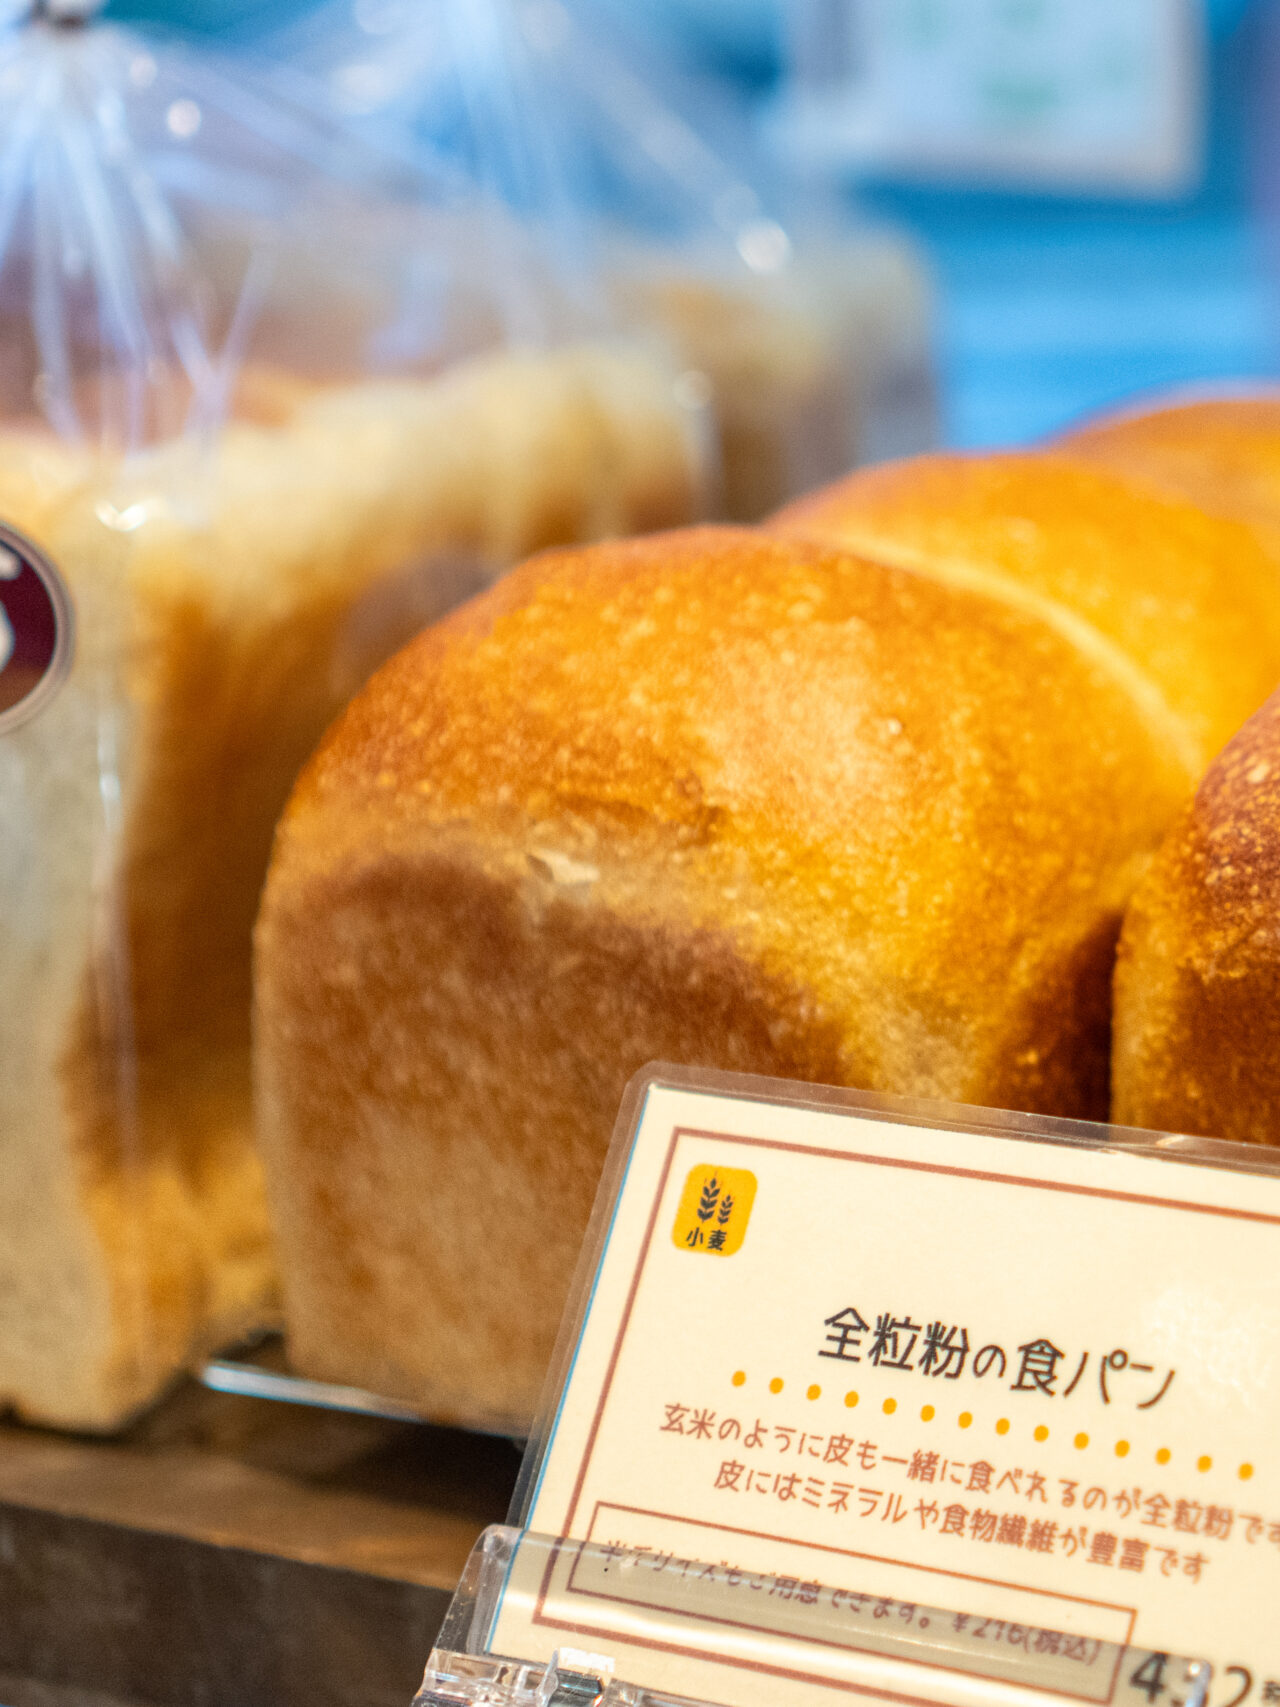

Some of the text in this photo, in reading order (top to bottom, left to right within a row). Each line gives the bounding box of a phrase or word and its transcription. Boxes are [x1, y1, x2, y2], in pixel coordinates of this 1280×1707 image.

[685, 1226, 728, 1252] 小麦
[817, 1306, 1176, 1410] 全粒粉の食パン
[713, 1458, 1211, 1585] 皮にはミネラルや食物繊維が豊富です
